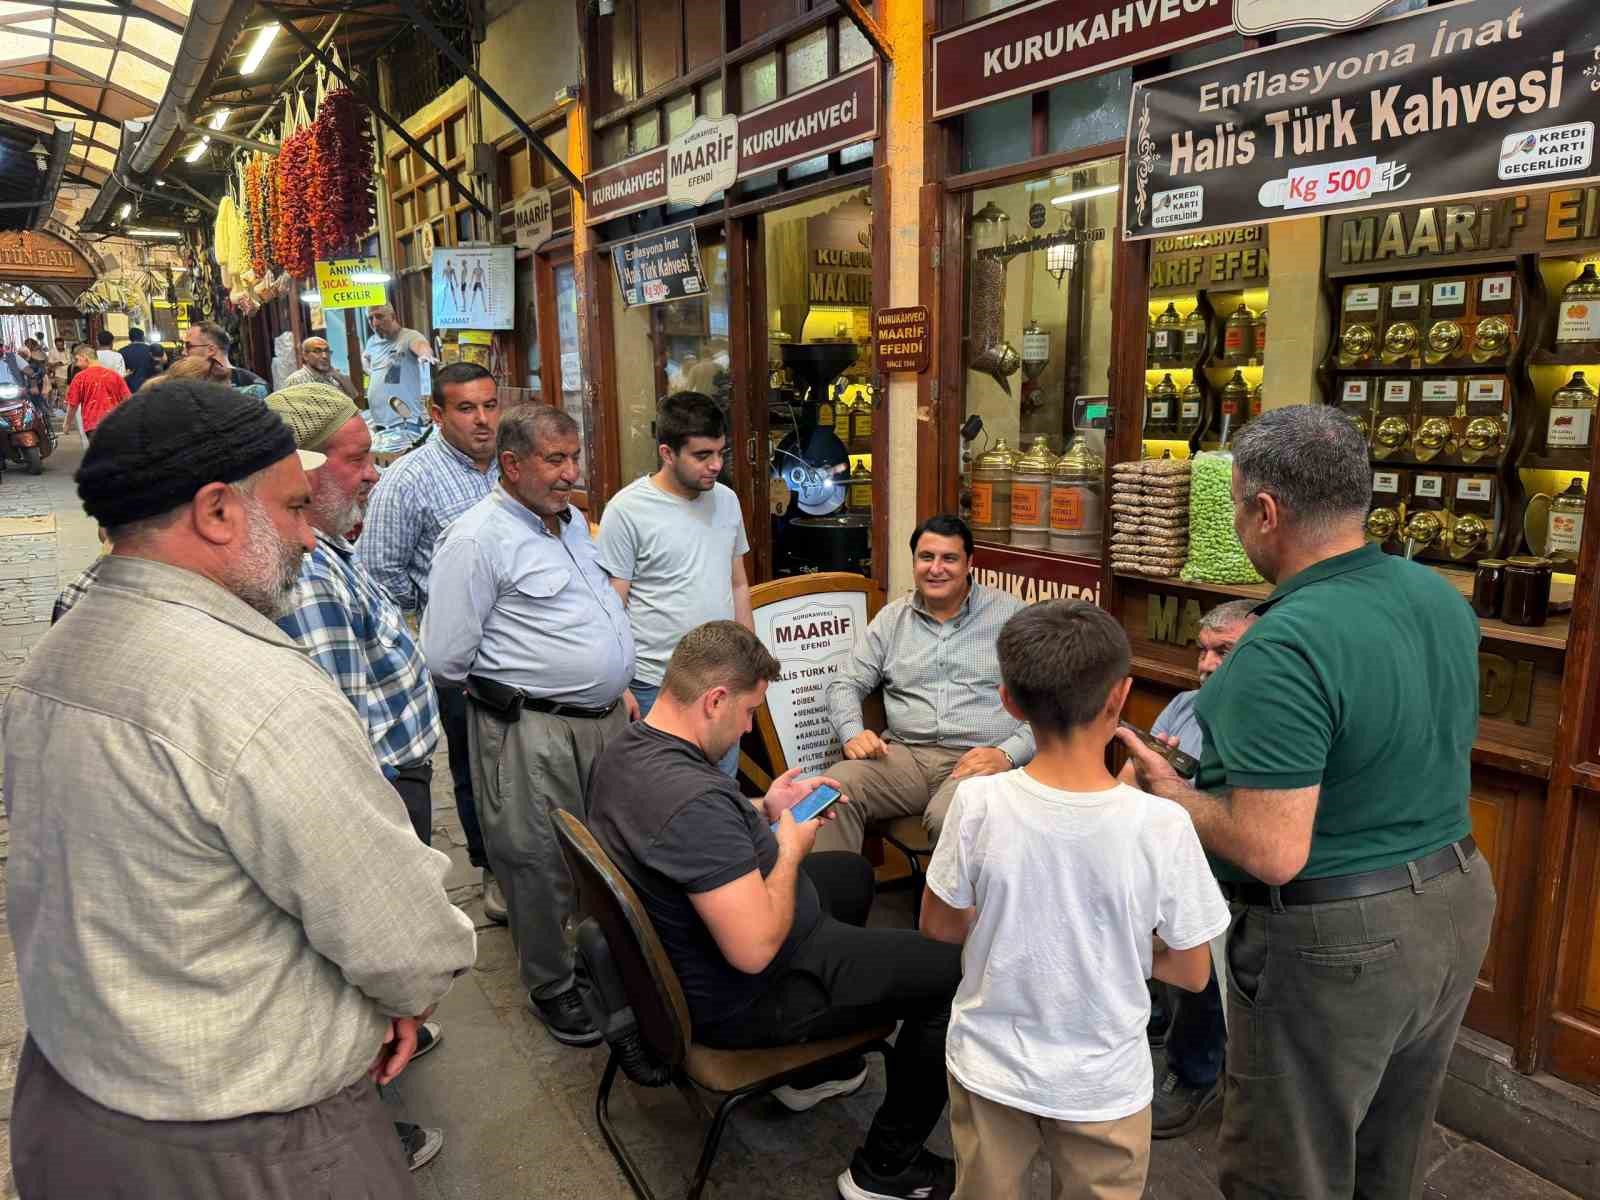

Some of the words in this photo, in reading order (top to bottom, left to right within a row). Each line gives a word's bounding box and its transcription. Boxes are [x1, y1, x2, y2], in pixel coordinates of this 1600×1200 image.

[1199, 41, 1416, 112] Enflasyona
[1430, 7, 1524, 58] İnat
[742, 92, 858, 158] KURUKAHVECİ
[1169, 122, 1256, 176] Halis
[1265, 98, 1358, 159] Türk
[1370, 51, 1567, 142] Kahvesi
[1540, 127, 1586, 142] KREDİ
[671, 132, 734, 178] MAARİF
[1538, 141, 1585, 155] KARTI
[1504, 155, 1583, 174] GEÇERLİDİR
[592, 162, 665, 207] KURUKAHVECİ
[688, 169, 713, 187] EFENDİ
[1289, 175, 1319, 202] Kg
[1326, 167, 1371, 194] 500
[879, 324, 924, 340] MAARİF
[880, 340, 923, 355] EFENDİ
[776, 615, 850, 643] MAARİF
[801, 640, 831, 651] EFENDİ
